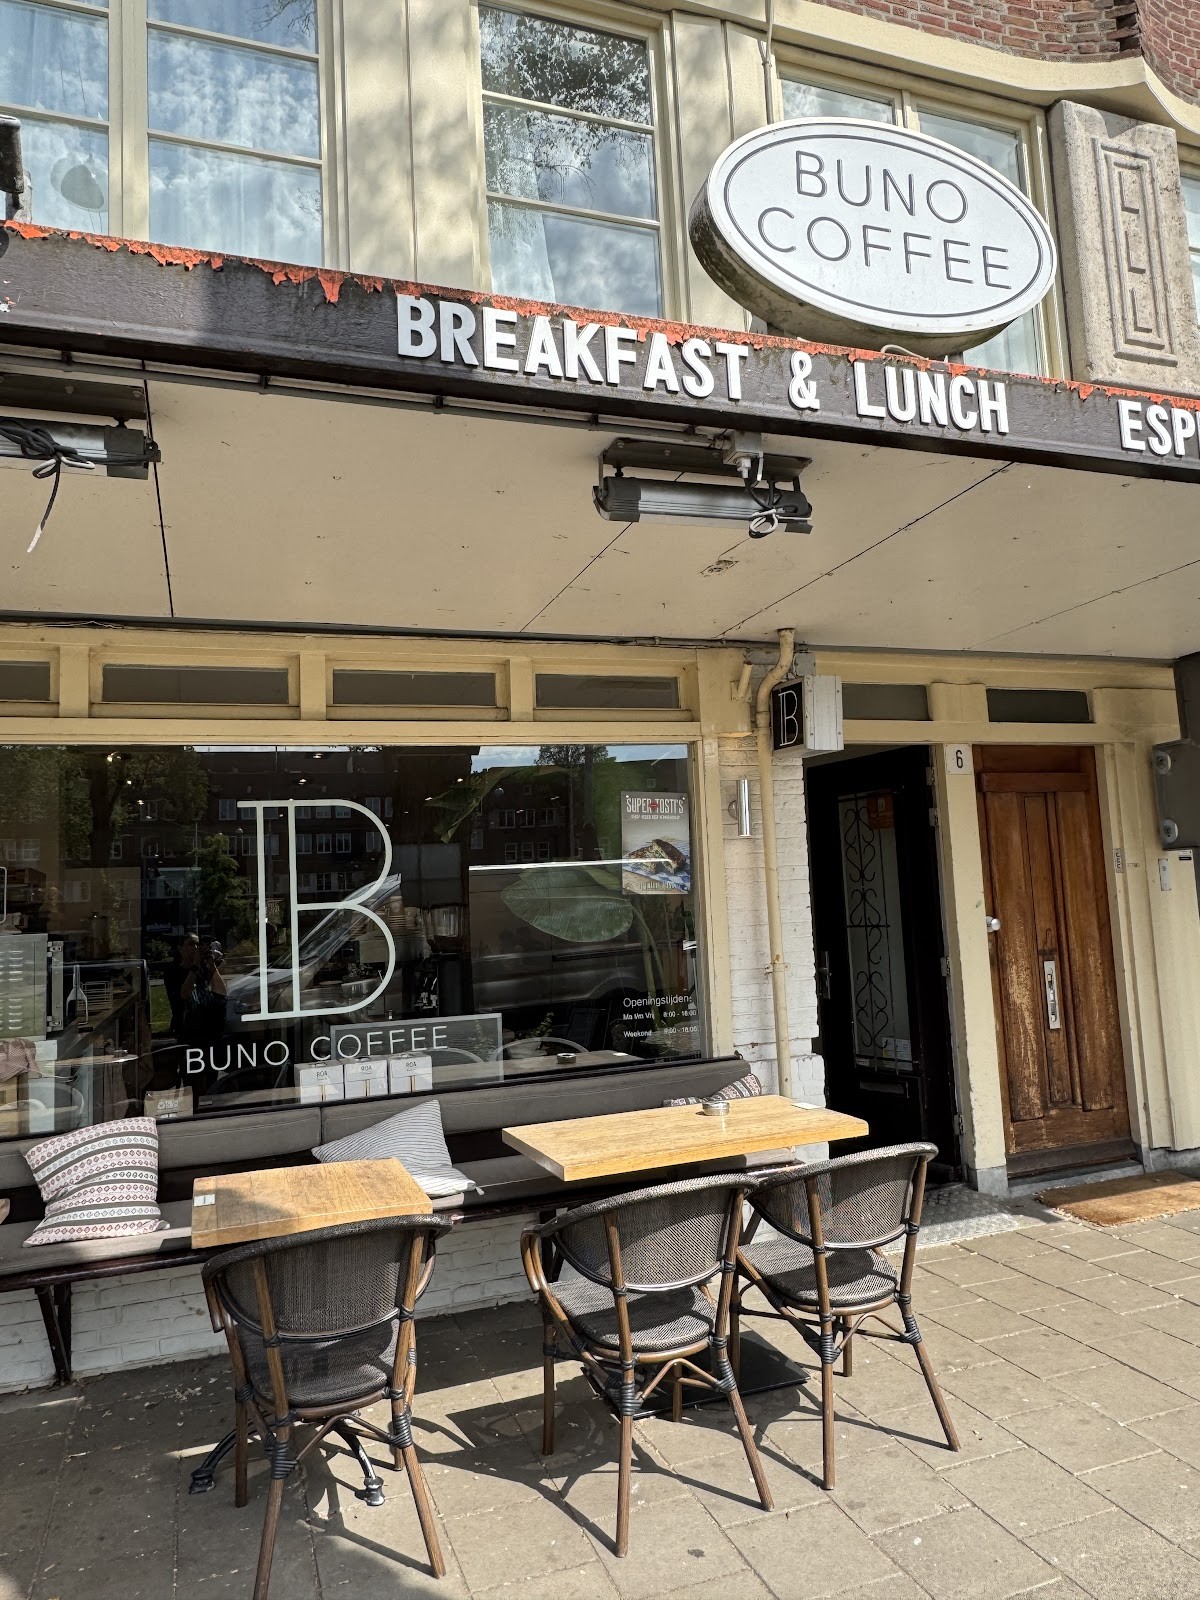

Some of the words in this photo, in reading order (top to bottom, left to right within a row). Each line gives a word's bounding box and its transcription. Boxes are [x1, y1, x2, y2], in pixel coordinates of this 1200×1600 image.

[795, 150, 969, 224] BUNO
[757, 207, 1012, 290] COFFEE
[397, 293, 749, 401] BREAKFAST
[788, 350, 820, 411] &
[855, 361, 1010, 434] LUNCH
[1117, 399, 1200, 459] ESP
[778, 690, 799, 747] B
[955, 749, 964, 769] 6
[626, 797, 652, 814] SUPER
[237, 798, 397, 1022] B
[623, 994, 692, 1009] Openingstijden:
[186, 1040, 290, 1074] BUNO
[310, 1025, 448, 1061] COFFEE
